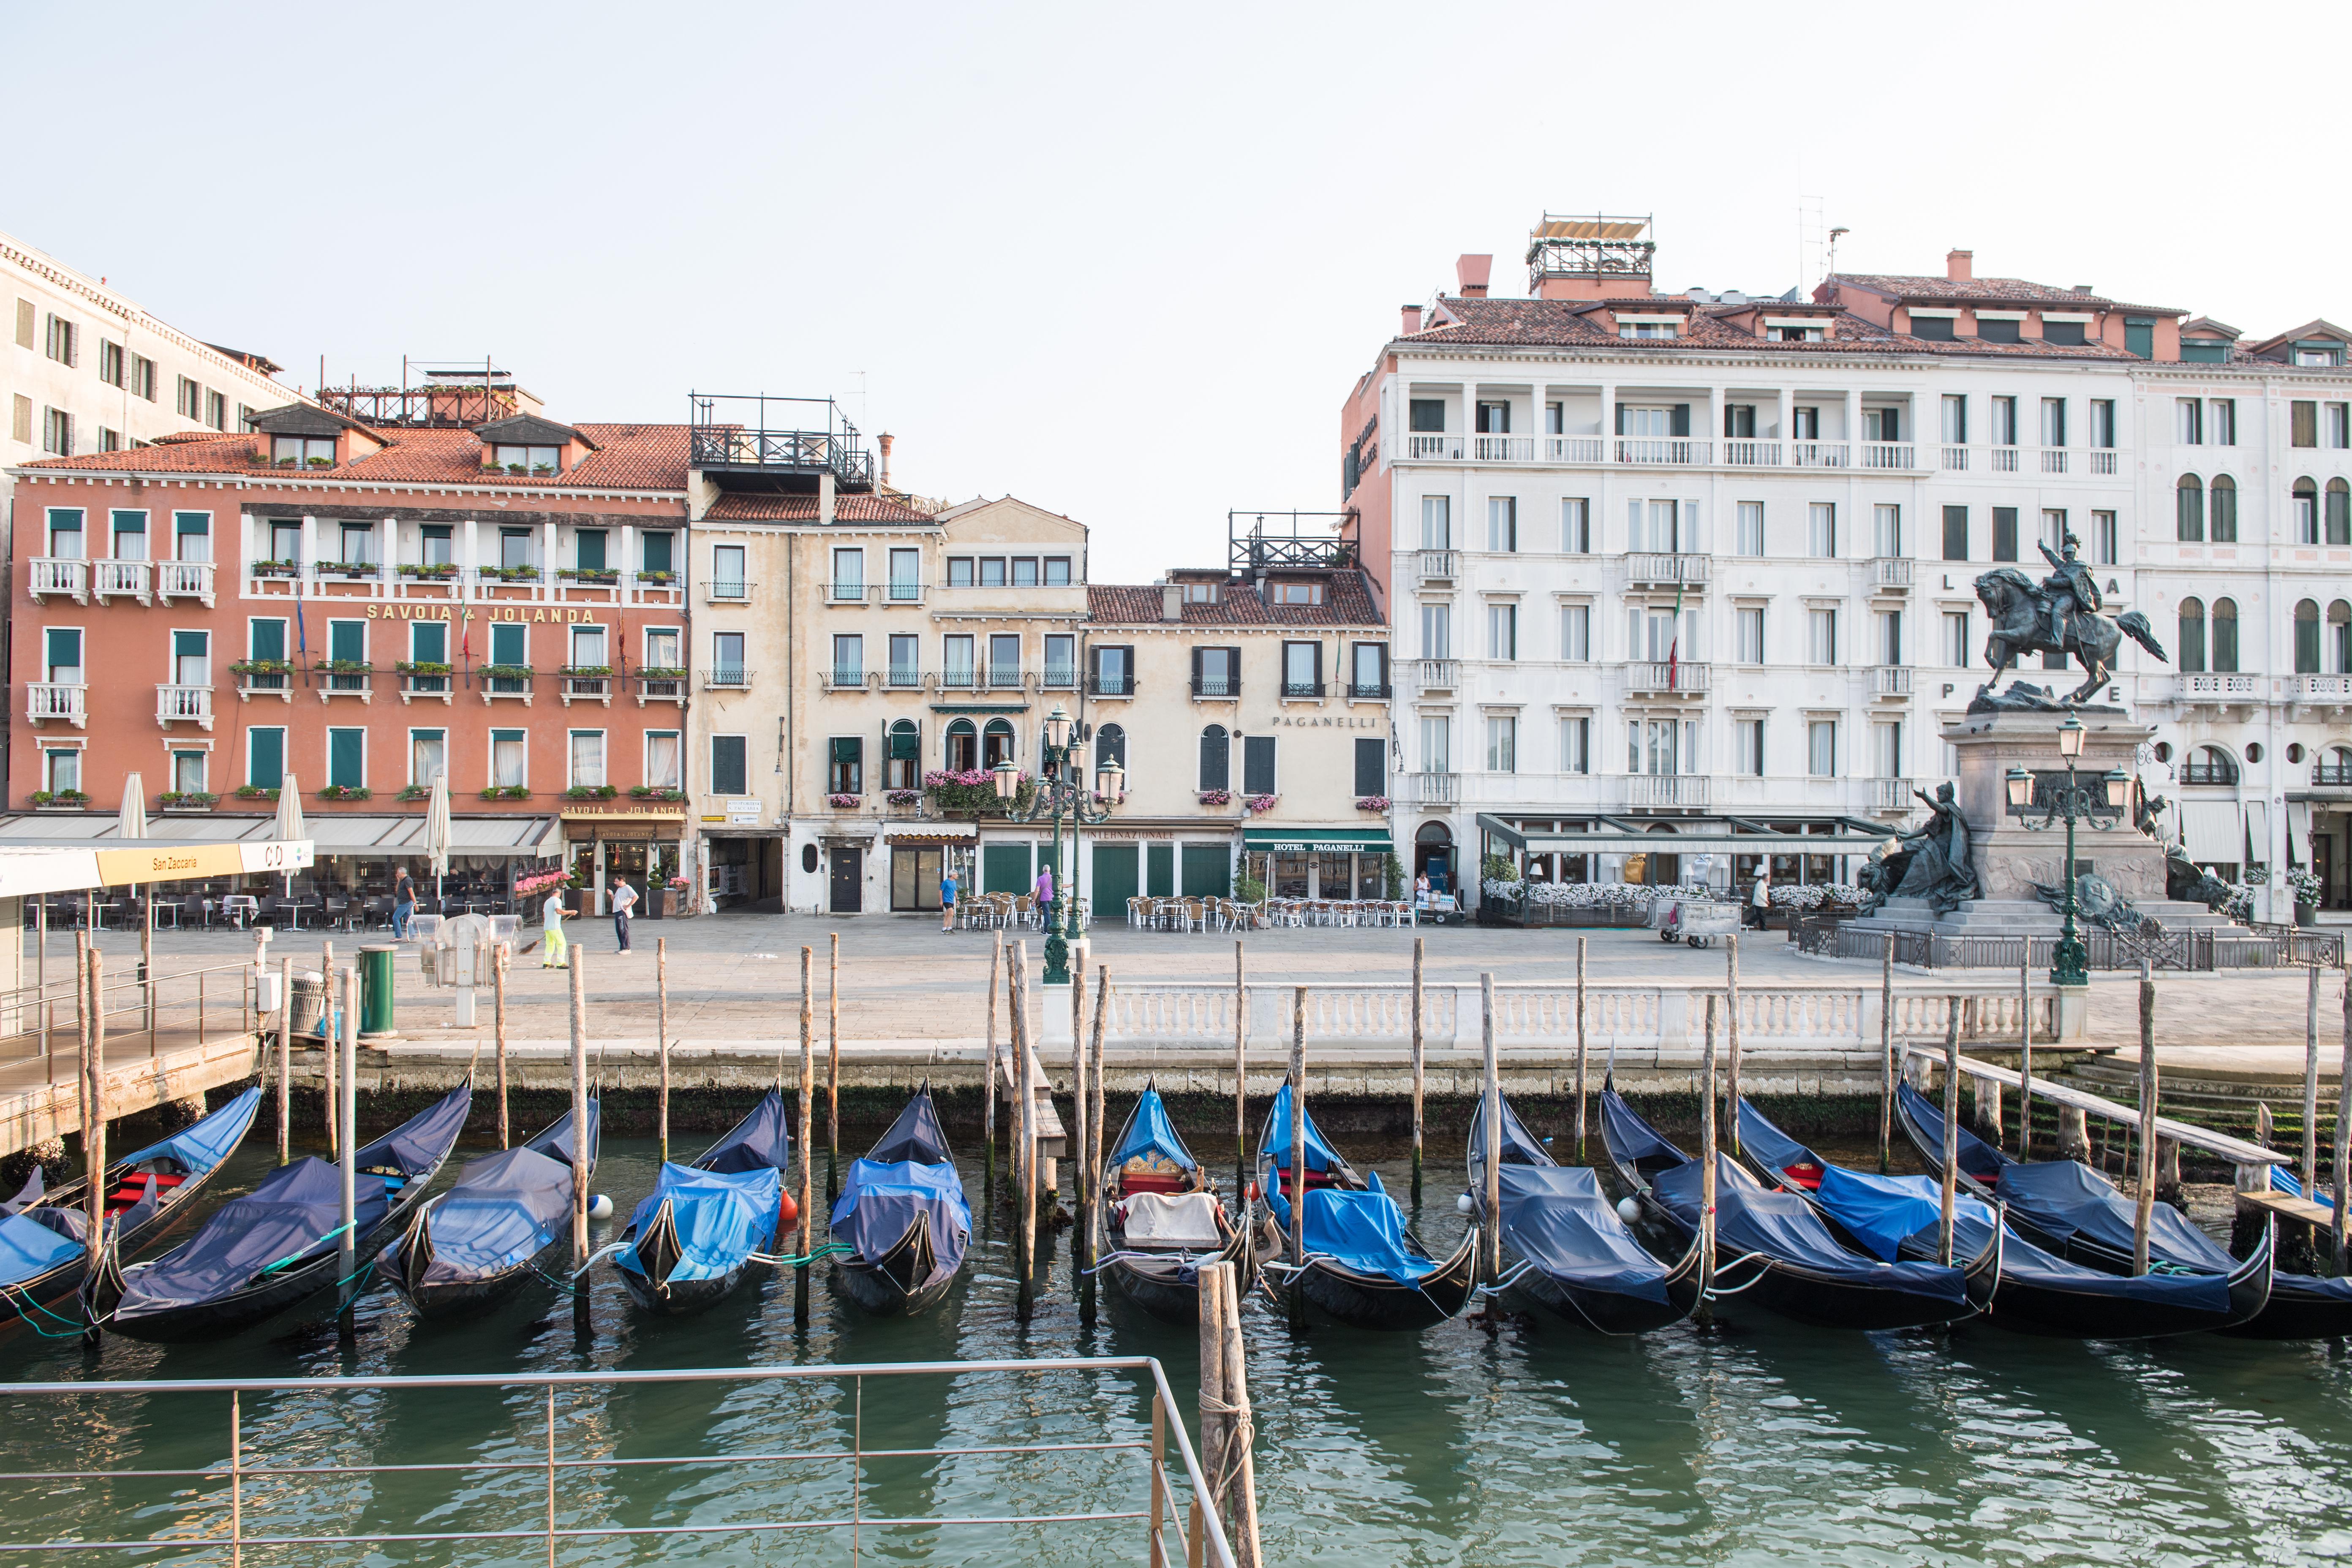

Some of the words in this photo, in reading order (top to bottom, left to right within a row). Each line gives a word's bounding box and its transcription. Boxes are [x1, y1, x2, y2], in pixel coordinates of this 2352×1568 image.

[367, 604, 452, 620] SAVOIA
[465, 609, 475, 620] &
[488, 607, 594, 623] JOLANDA
[1273, 717, 1375, 727] PAGANELLI
[627, 806, 681, 814] JOLANDA
[1088, 830, 1175, 839] INTERNAZIONALE
[266, 846, 272, 867] C
[276, 845, 283, 866] D
[153, 858, 166, 871] San
[168, 856, 197, 870] Zaccaria
